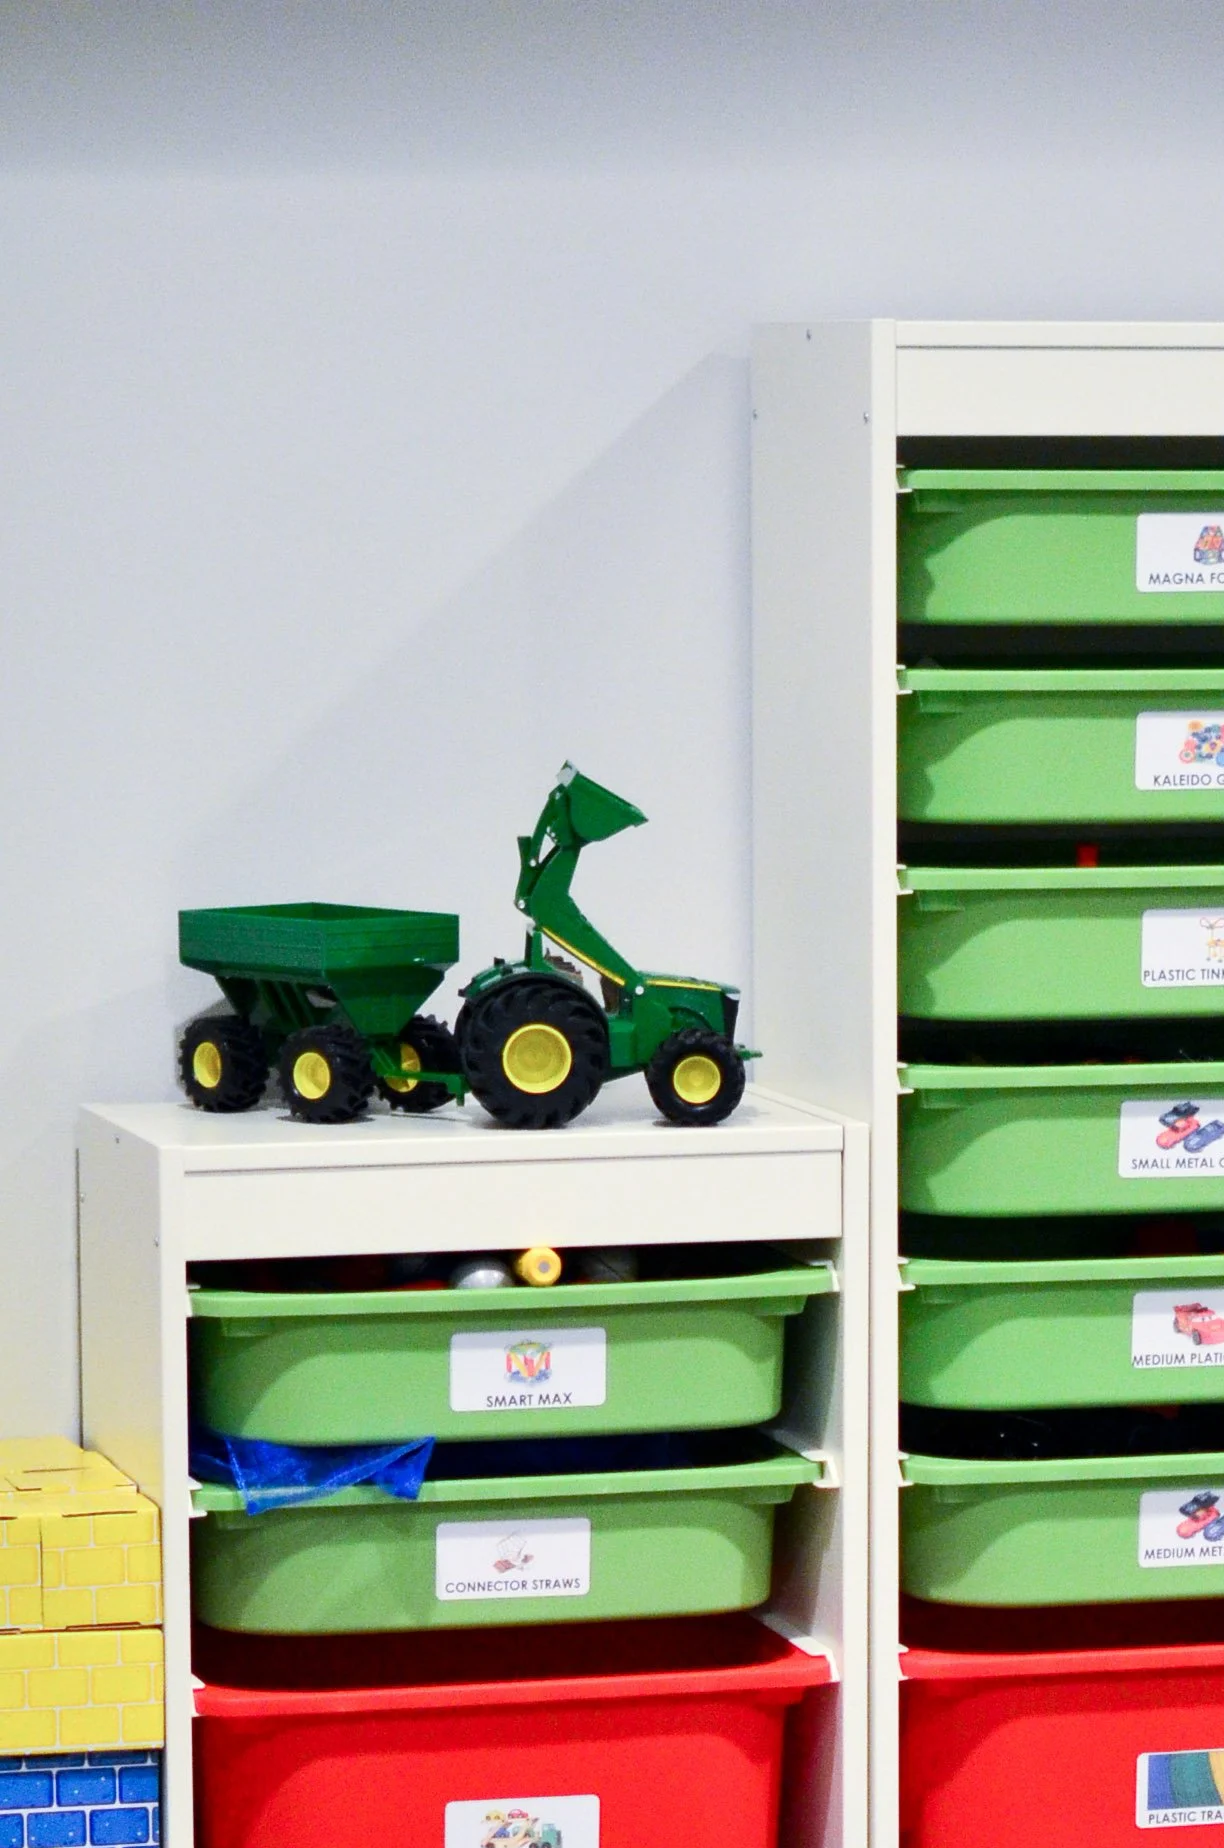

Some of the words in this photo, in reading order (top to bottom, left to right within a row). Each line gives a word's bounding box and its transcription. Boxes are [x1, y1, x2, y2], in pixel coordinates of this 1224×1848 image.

[1148, 572, 1204, 585] MAGNA
[1153, 774, 1212, 787] KALEIDO
[1143, 968, 1197, 982] PLASTIC
[1131, 1157, 1171, 1170] SMALL
[1175, 1157, 1215, 1169] METAL
[1131, 1352, 1186, 1366] MEDIUM
[485, 1394, 534, 1408] SMART
[537, 1392, 572, 1405] MAX
[1144, 1546, 1196, 1560] MEDIUM
[445, 1579, 528, 1594] CONNECTOR
[532, 1578, 581, 1591] STRAWS
[1148, 1810, 1197, 1825] PLASTIC
